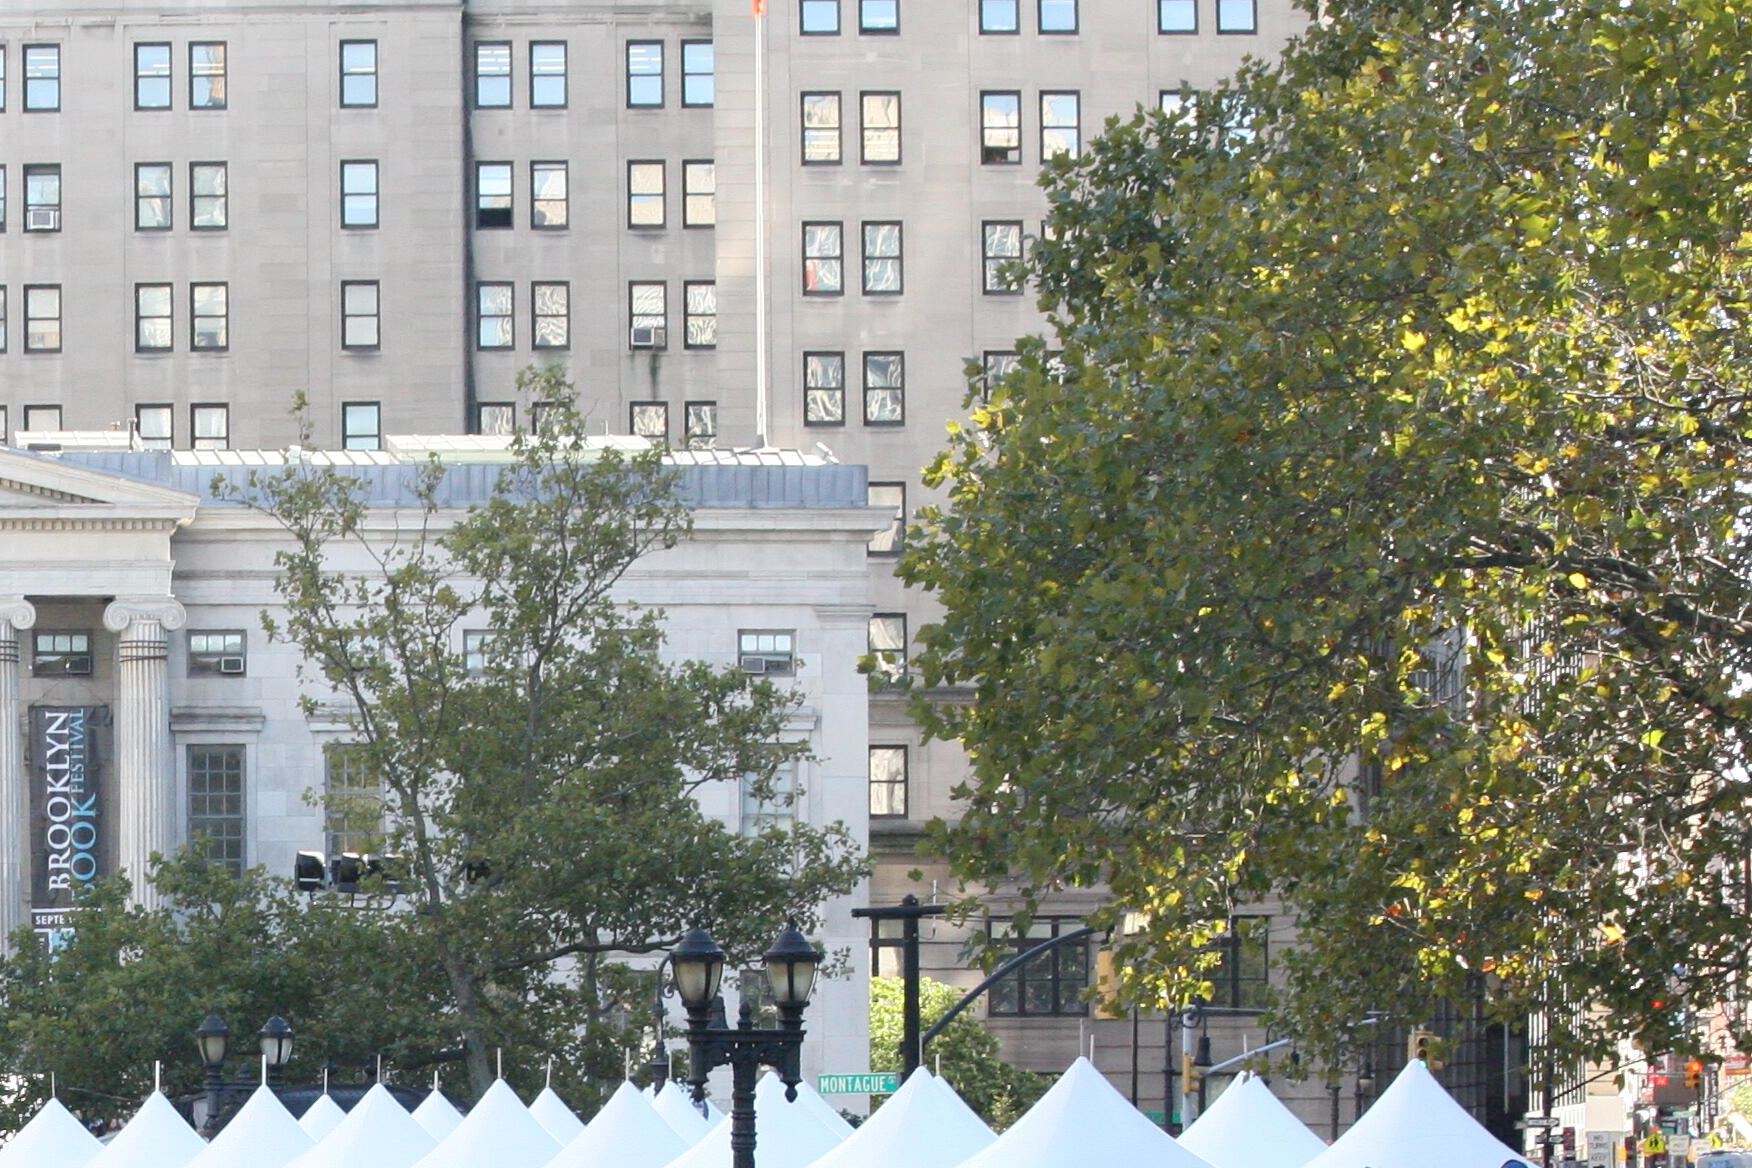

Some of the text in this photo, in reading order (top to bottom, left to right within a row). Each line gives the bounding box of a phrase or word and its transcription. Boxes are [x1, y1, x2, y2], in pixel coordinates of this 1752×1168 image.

[70, 708, 84, 793] FESTIVAL
[46, 711, 71, 890] BROOKLYN
[820, 1076, 886, 1093] MONTAGUE
